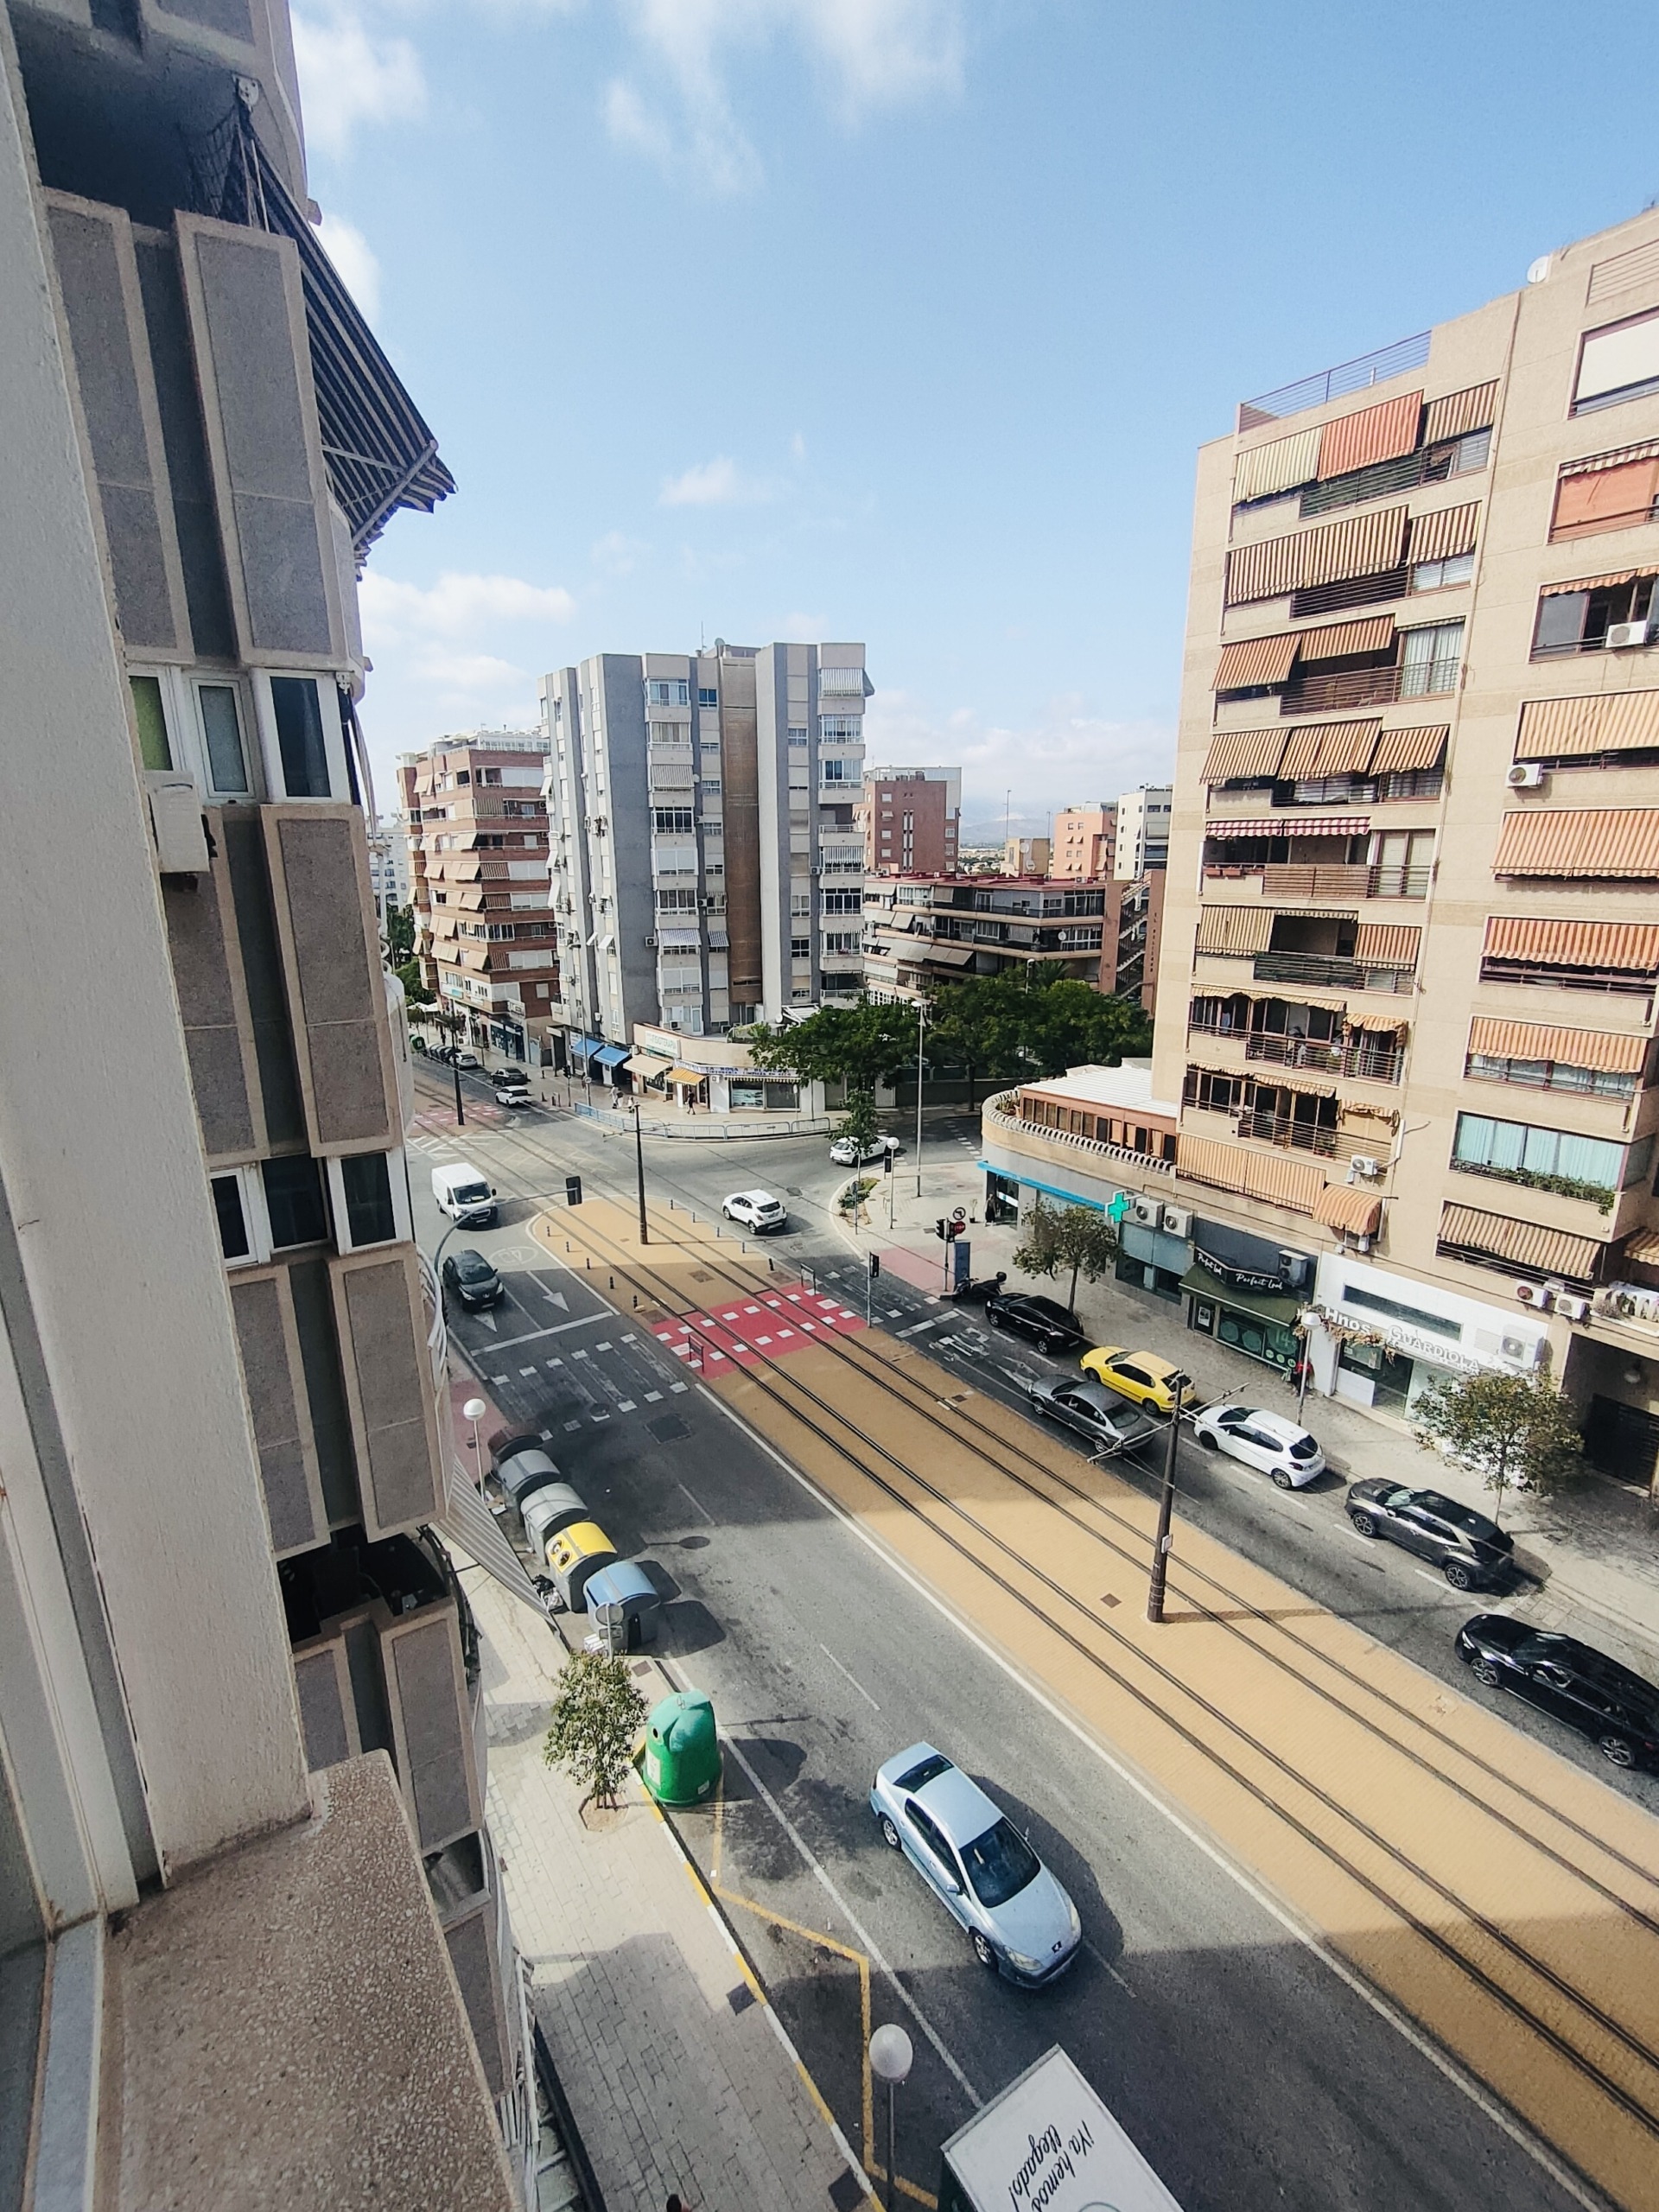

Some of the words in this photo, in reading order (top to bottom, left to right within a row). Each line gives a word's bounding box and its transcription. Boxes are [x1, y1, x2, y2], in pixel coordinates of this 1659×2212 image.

[1236, 1273, 1268, 1286] Perfect
[1325, 1306, 1372, 1335] Hnos
[1068, 2120, 1095, 2157] ¡Ya
[1008, 2124, 1062, 2212] llegado!
[1032, 2150, 1076, 2212] hemos
